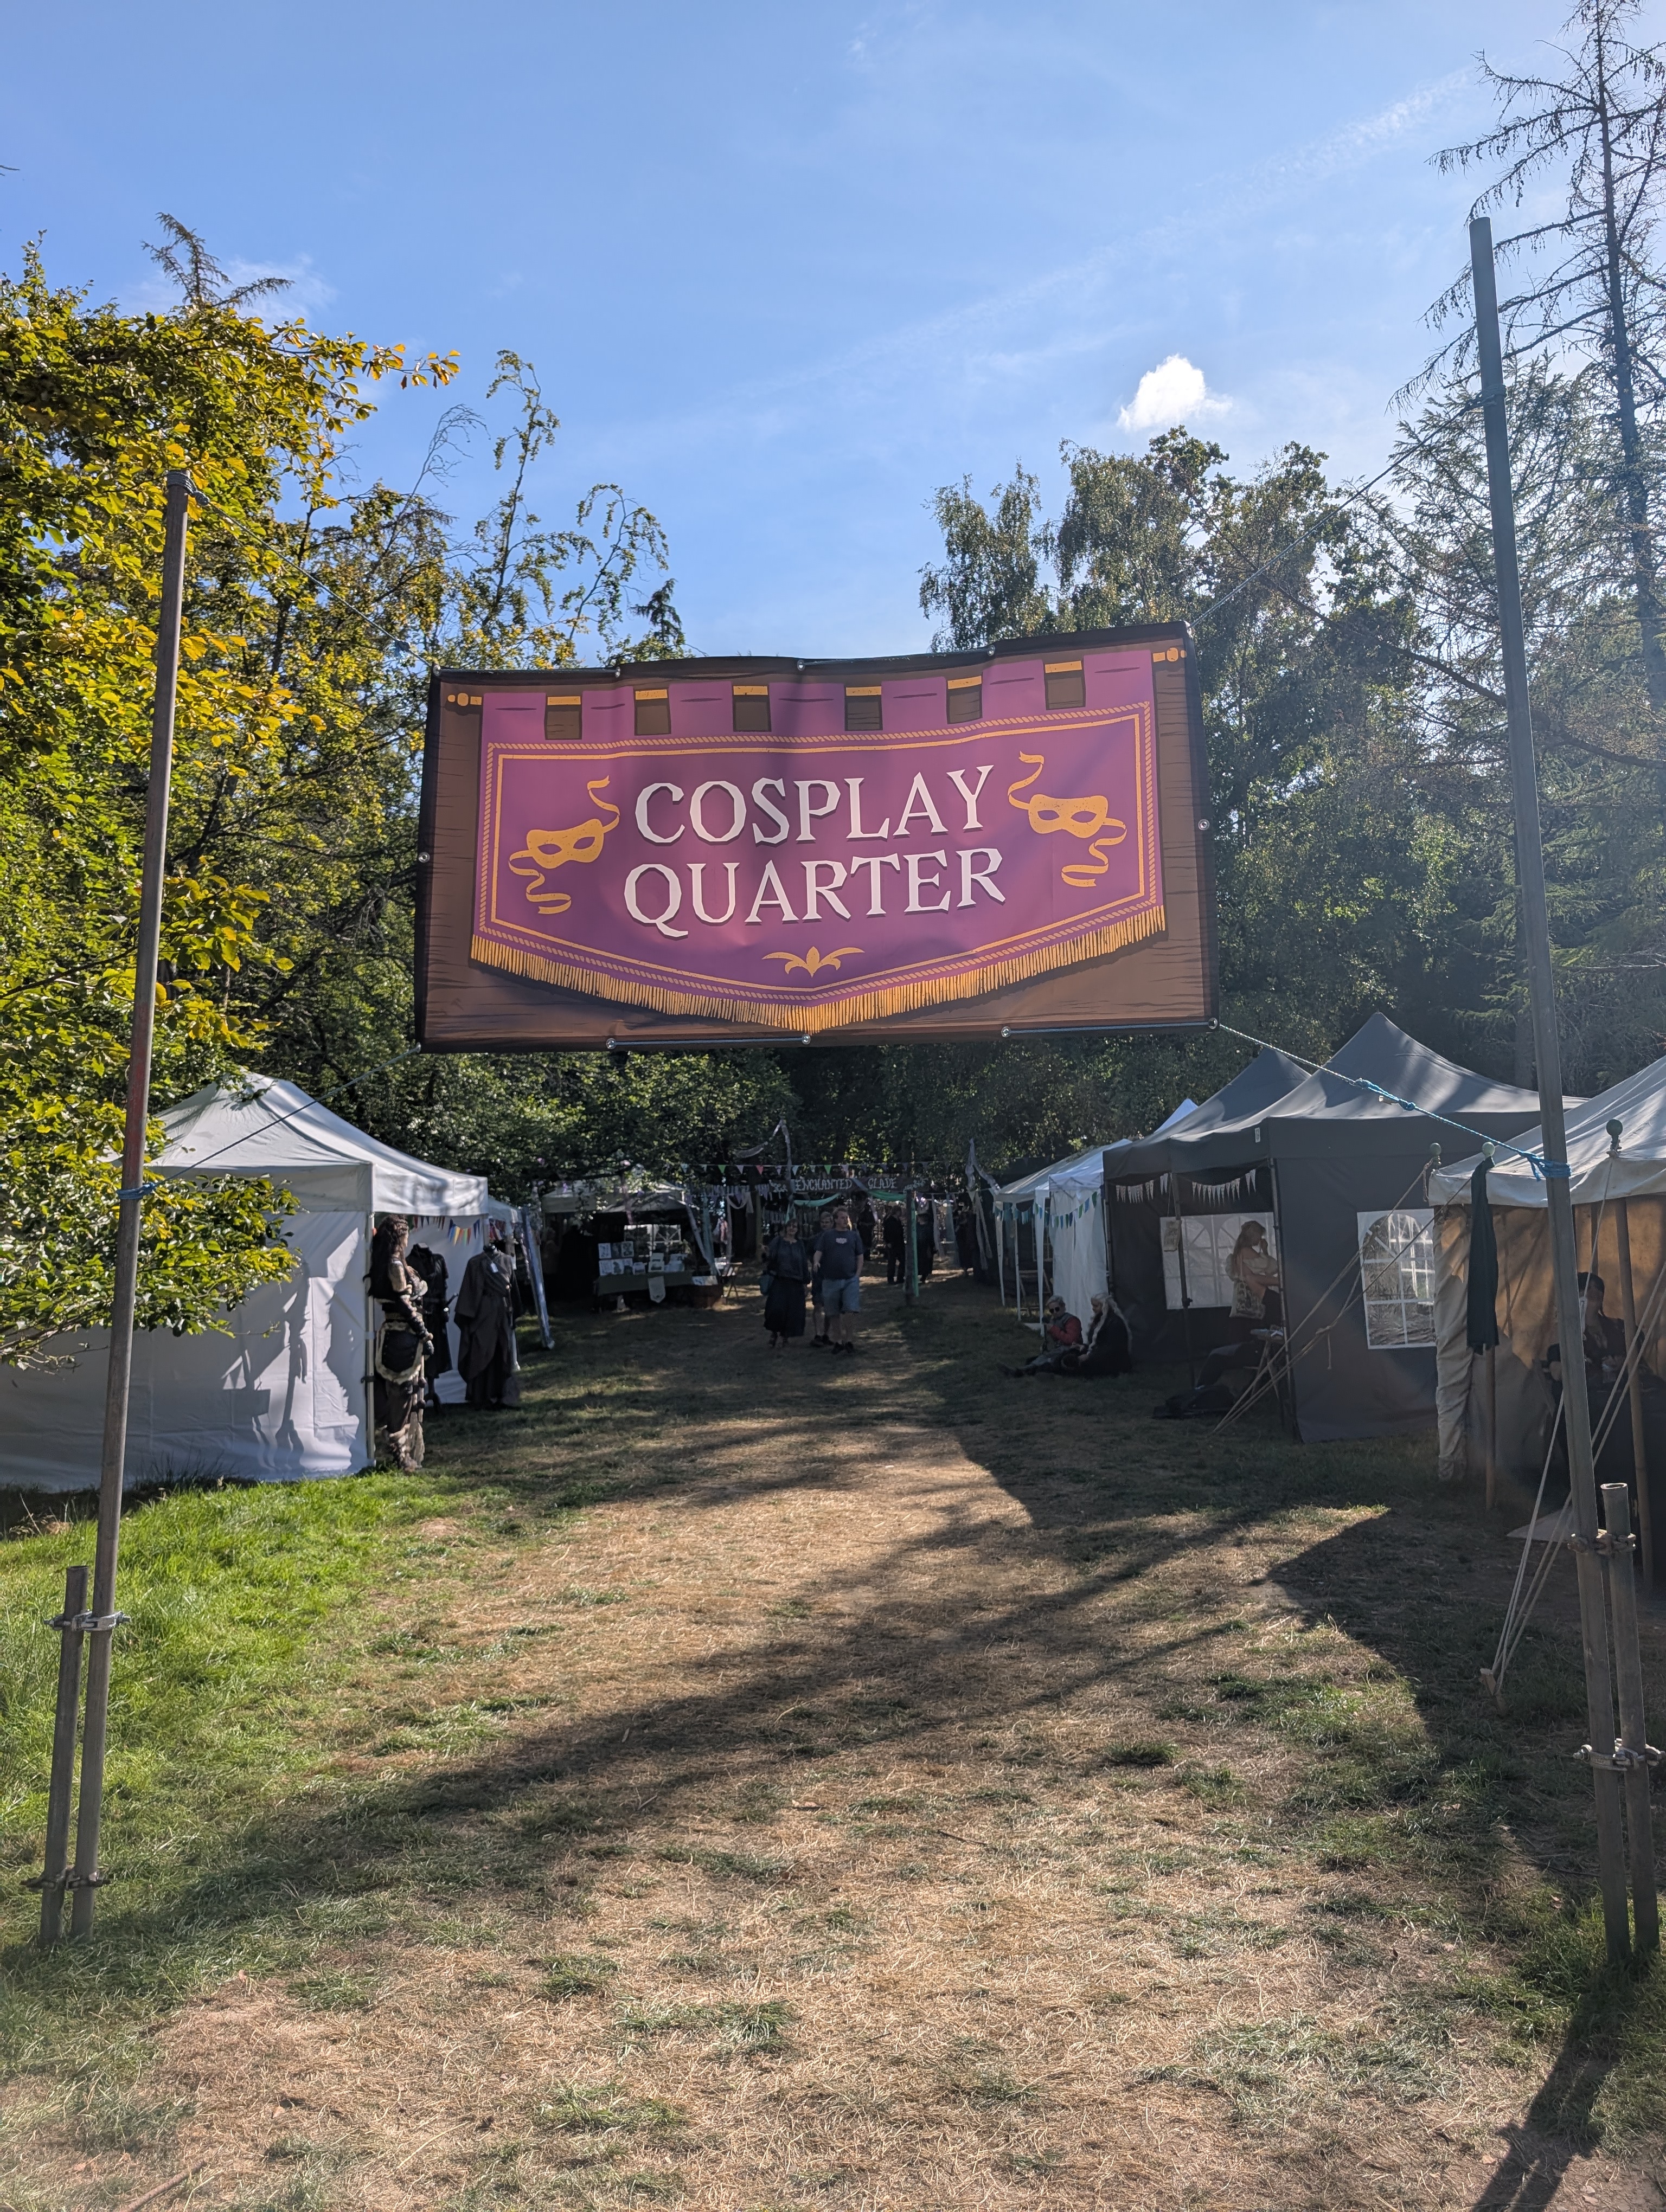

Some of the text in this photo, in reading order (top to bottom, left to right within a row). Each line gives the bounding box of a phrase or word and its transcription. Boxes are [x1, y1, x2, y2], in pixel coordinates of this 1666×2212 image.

[635, 765, 994, 845] COSPLAY
[624, 848, 1005, 938] QUARTER
[796, 1177, 898, 1191] ENCHANTED GLADE
